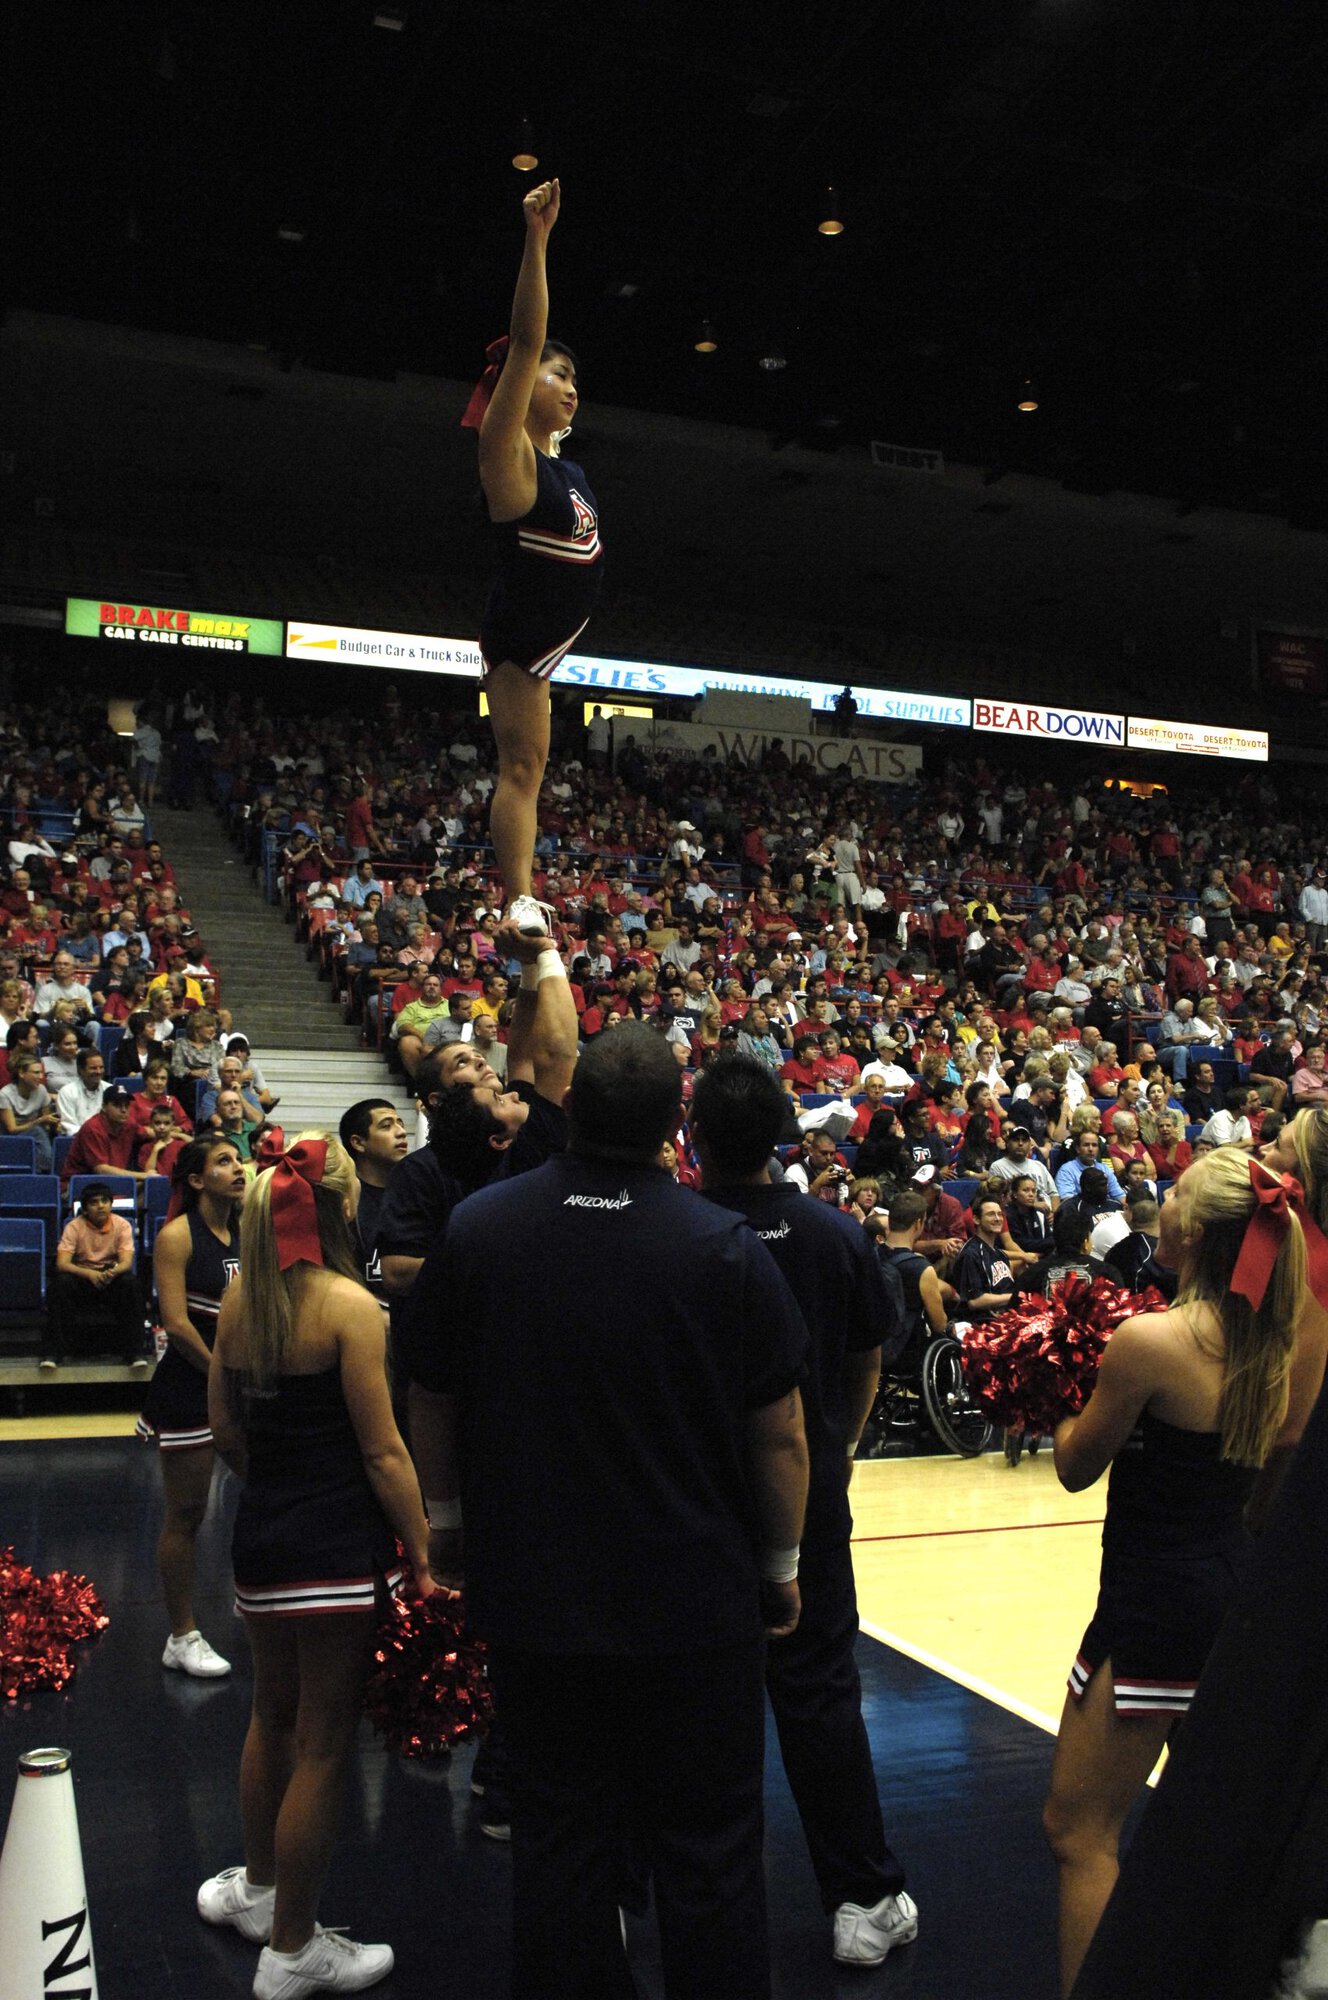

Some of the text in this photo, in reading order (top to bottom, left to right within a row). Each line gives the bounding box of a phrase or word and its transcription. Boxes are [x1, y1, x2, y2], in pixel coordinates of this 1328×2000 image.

[104, 626, 244, 651] CAR CARE CENTERS
[340, 639, 382, 655] Budget
[385, 644, 404, 657] Car
[408, 647, 416, 658] &
[420, 647, 452, 662] Truck
[884, 700, 964, 723] SUPPLIES
[1128, 726, 1194, 741] DESERT TOYOTA
[1203, 735, 1233, 746] DESERT
[1236, 738, 1267, 749] TOYOTA
[563, 1194, 621, 1210] ARIZONA
